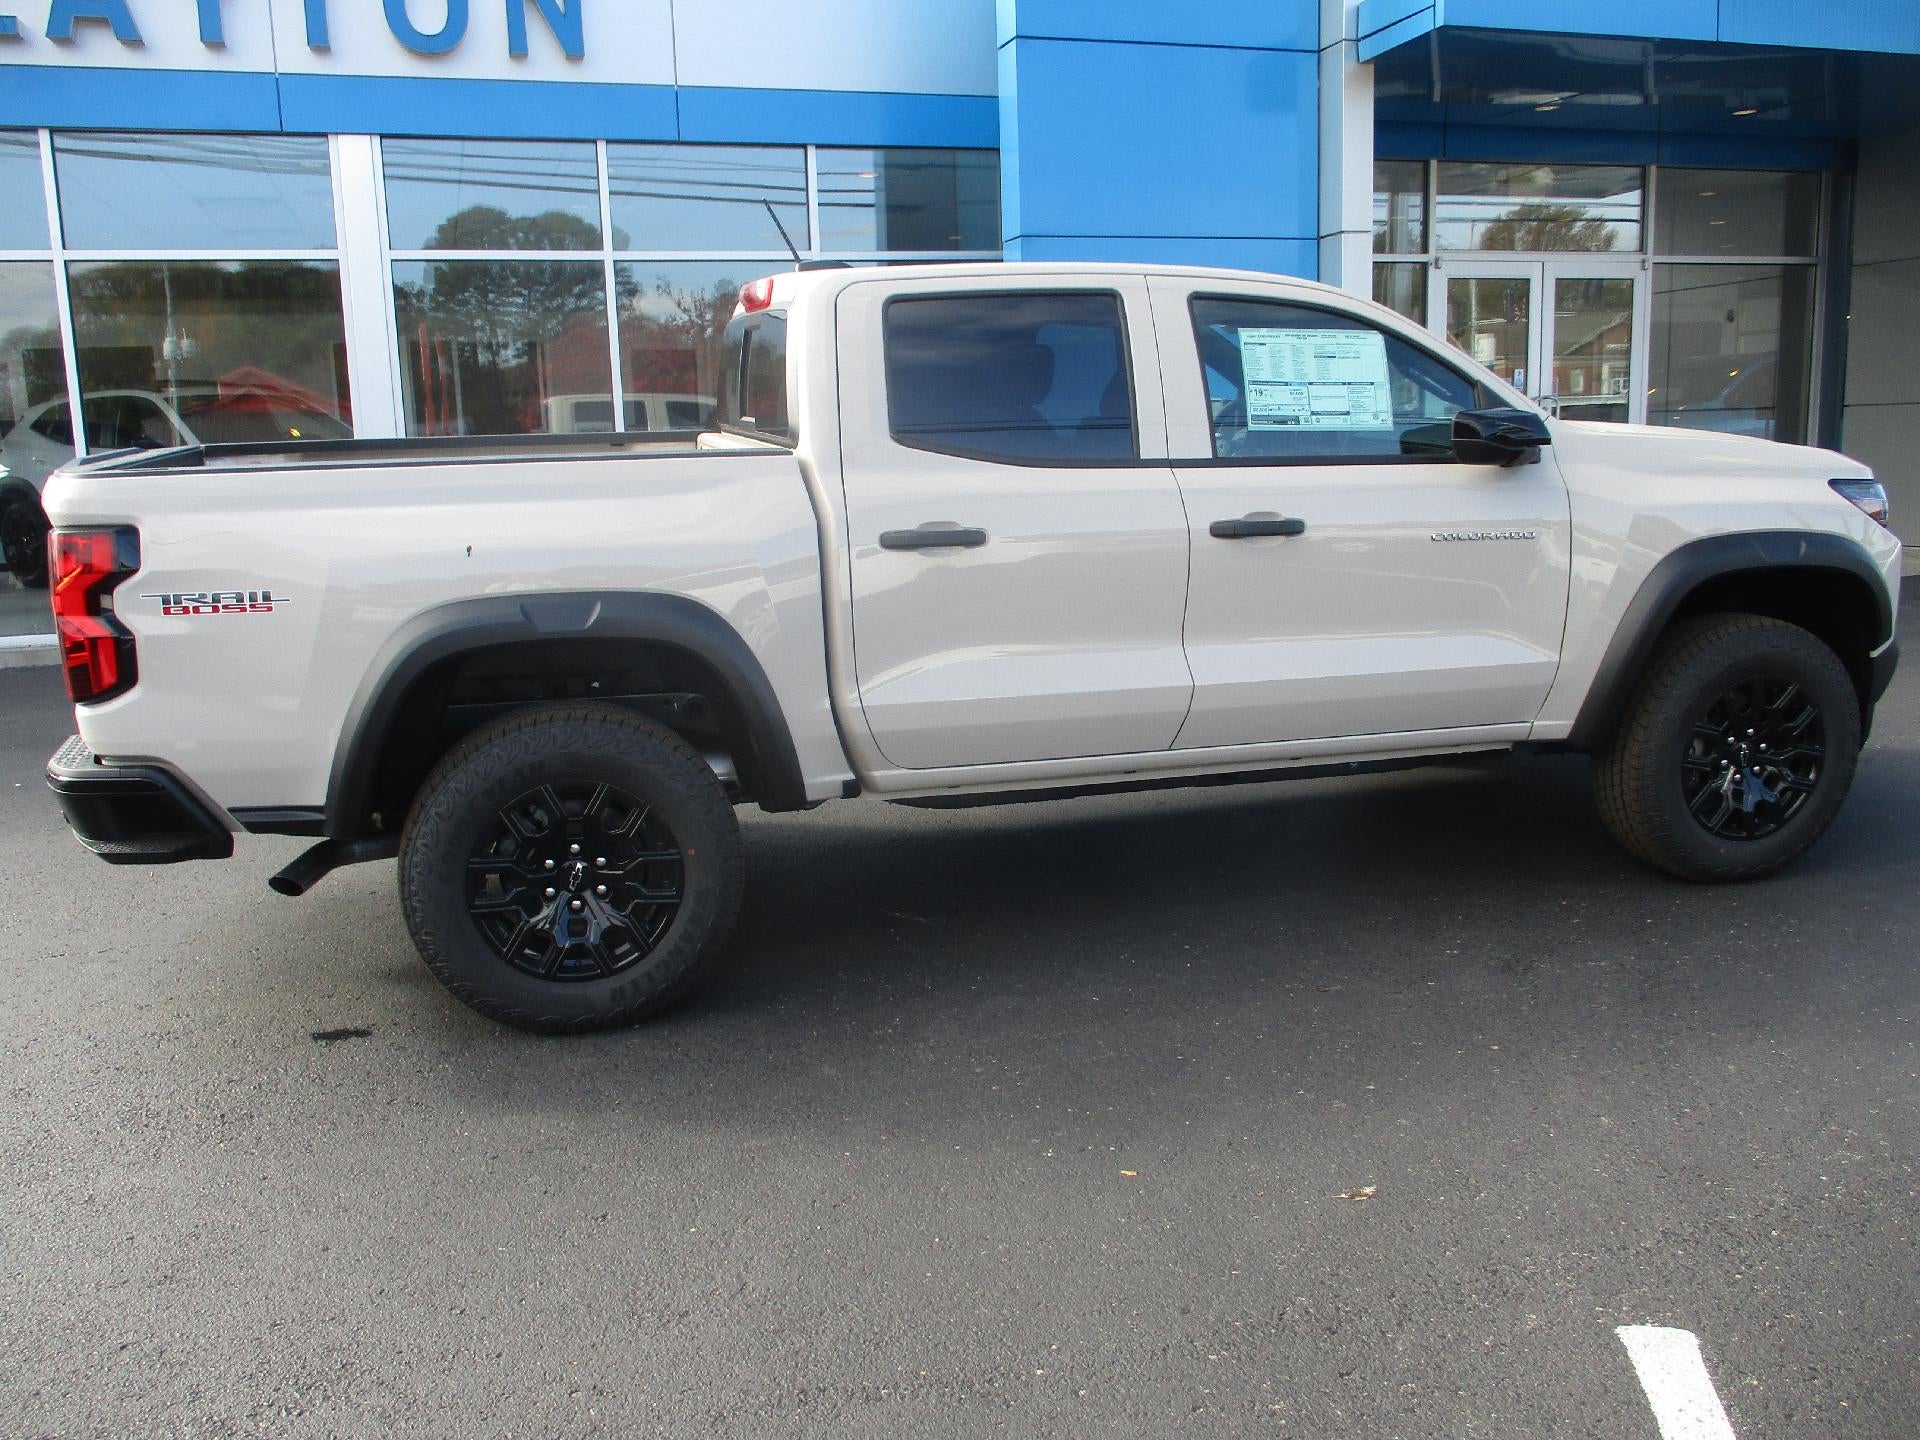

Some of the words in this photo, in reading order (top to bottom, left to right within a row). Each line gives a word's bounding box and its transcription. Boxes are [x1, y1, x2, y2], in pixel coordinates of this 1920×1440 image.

[1253, 388, 1264, 397] 19
[1430, 530, 1537, 542] COLORADO
[140, 589, 291, 605] TRAIL
[162, 603, 274, 616] BOSS
